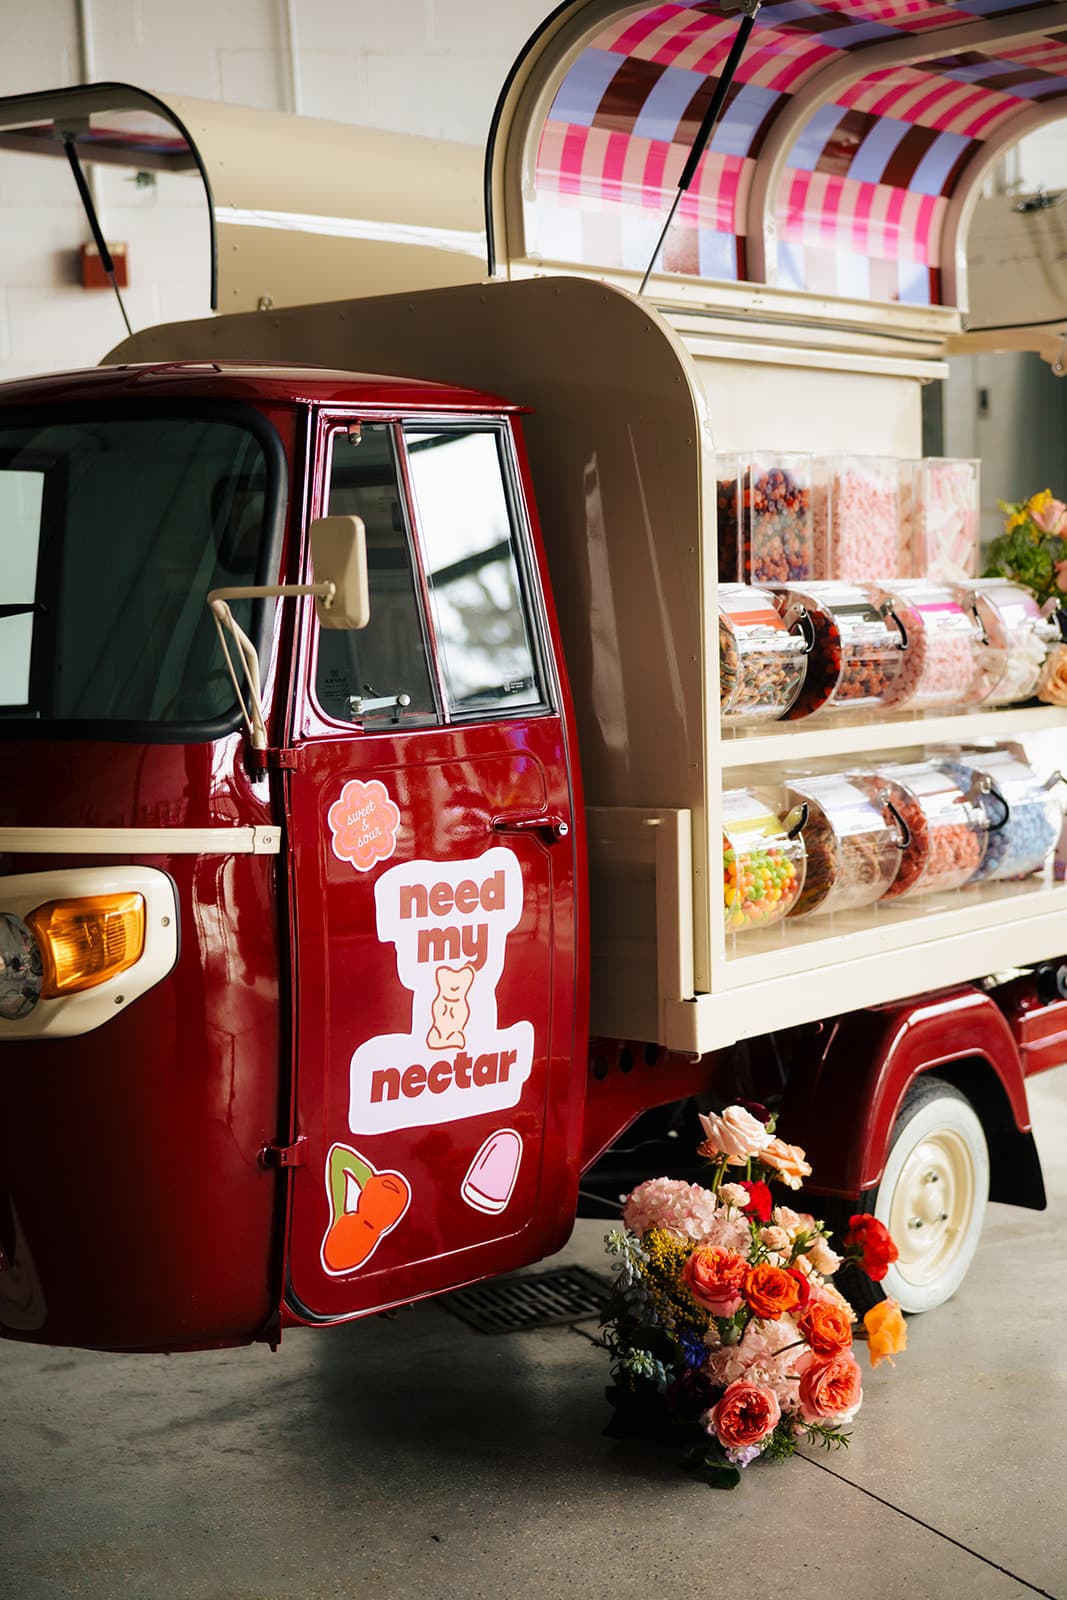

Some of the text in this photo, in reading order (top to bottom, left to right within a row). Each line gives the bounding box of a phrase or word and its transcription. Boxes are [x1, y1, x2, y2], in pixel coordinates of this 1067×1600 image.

[346, 799, 376, 826] sweet
[361, 817, 370, 831] &
[357, 827, 382, 848] sour
[399, 870, 506, 919] need
[417, 923, 489, 970] my
[370, 1049, 518, 1104] nectar
